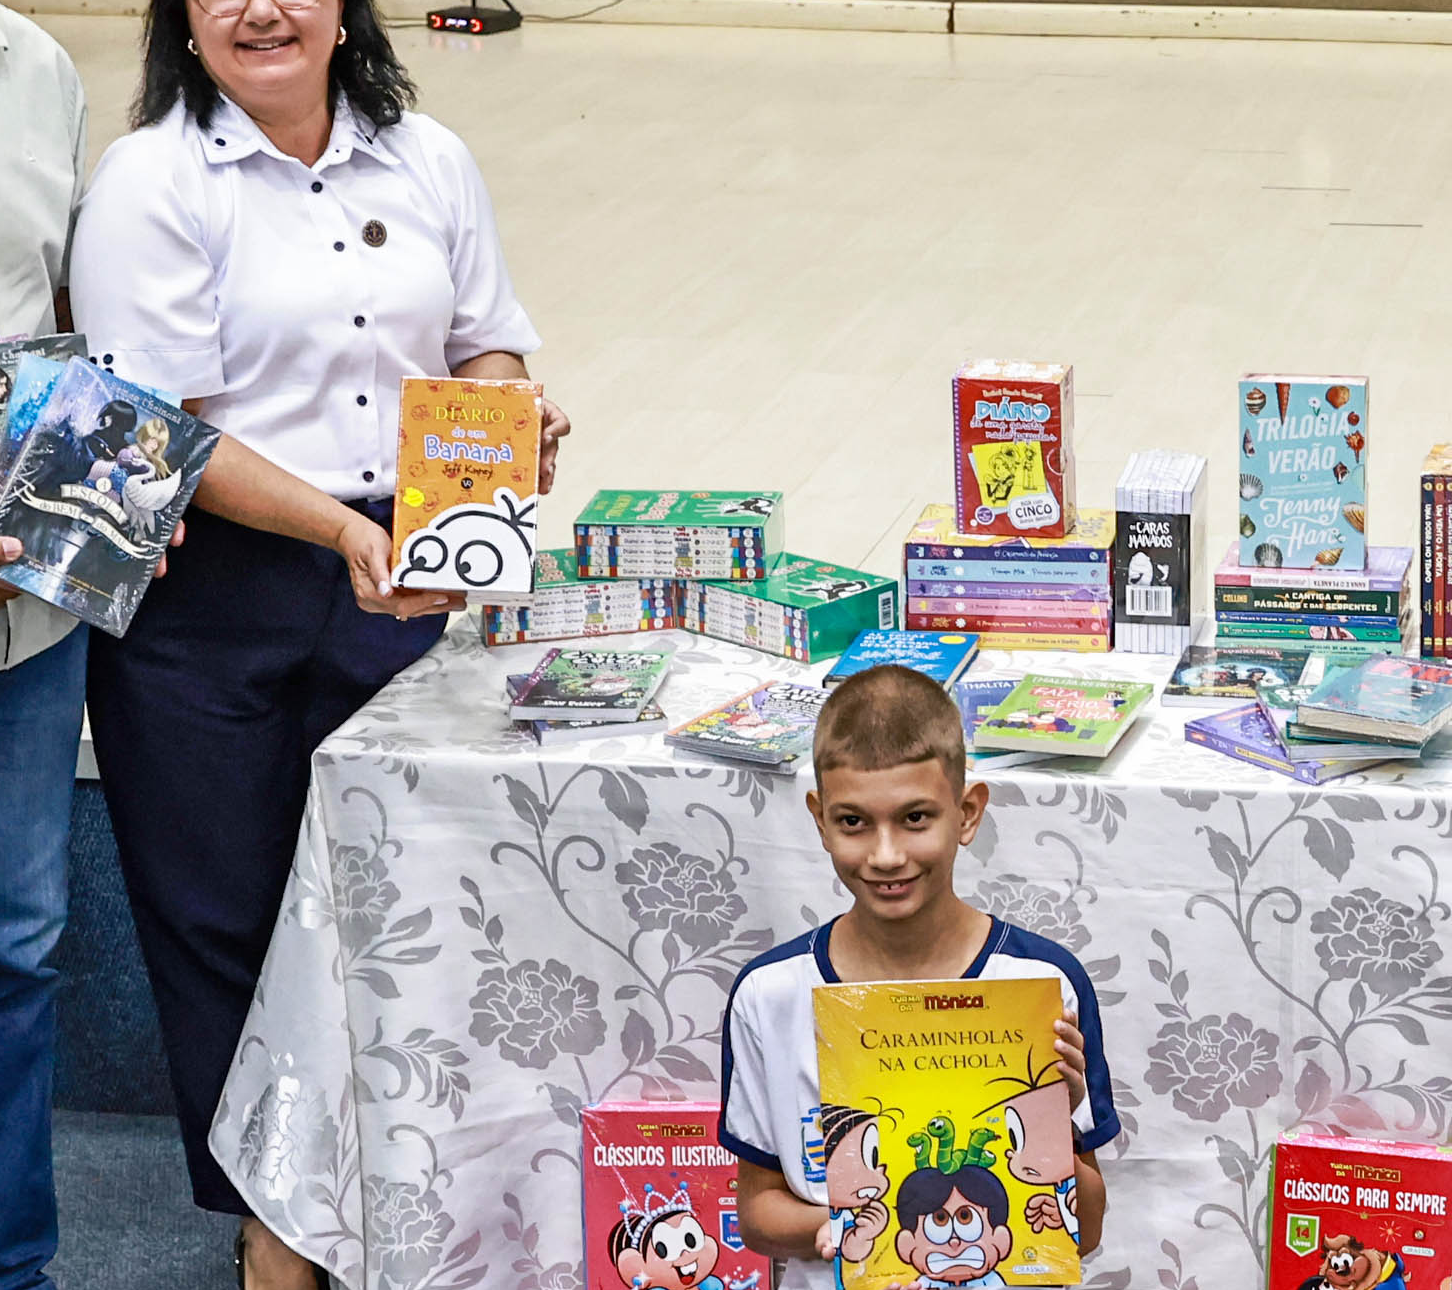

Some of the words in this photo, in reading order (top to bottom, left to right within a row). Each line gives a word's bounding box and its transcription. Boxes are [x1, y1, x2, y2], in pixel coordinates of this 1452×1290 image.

[975, 397, 1051, 422] DIÁRIO
[452, 426, 466, 438] de
[1257, 411, 1350, 442] TRILOGIA
[423, 434, 513, 463] Banana
[1268, 443, 1337, 474] VERÃO
[442, 463, 461, 474] Jeff
[464, 465, 494, 480] Kinney
[68, 488, 125, 522] ESCOLA
[1015, 504, 1052, 518] CINCO
[1260, 496, 1341, 528] Jenny
[1436, 505, 1444, 516] UM
[1136, 522, 1170, 536] CARAS
[1266, 516, 1347, 557] Han
[1425, 521, 1433, 545] DOBRA
[1436, 518, 1444, 543] VENTO
[1425, 546, 1433, 558] NO
[1425, 559, 1433, 583] TEMPO
[1436, 552, 1444, 577] PORTA
[1222, 594, 1248, 603] COLLINS
[1254, 599, 1302, 608] PÁSSAROS
[1325, 603, 1378, 612] SERPENTES
[1291, 592, 1331, 601] CANTIGA
[1033, 686, 1080, 698] FALA
[891, 996, 921, 1004] TURMA
[900, 1004, 913, 1012] DA
[860, 1028, 1025, 1050] CARAMINHOLAS
[879, 1056, 906, 1072] NA
[914, 1053, 1009, 1071] CACHOLA
[594, 1143, 665, 1167] CLÁSSICOS
[672, 1145, 739, 1166] ILUSTRAD
[1284, 1178, 1350, 1205] CLÁSSICOS
[1356, 1188, 1389, 1209] PARA
[1396, 1191, 1447, 1215] SEMPRE
[1295, 1226, 1310, 1238] 14
